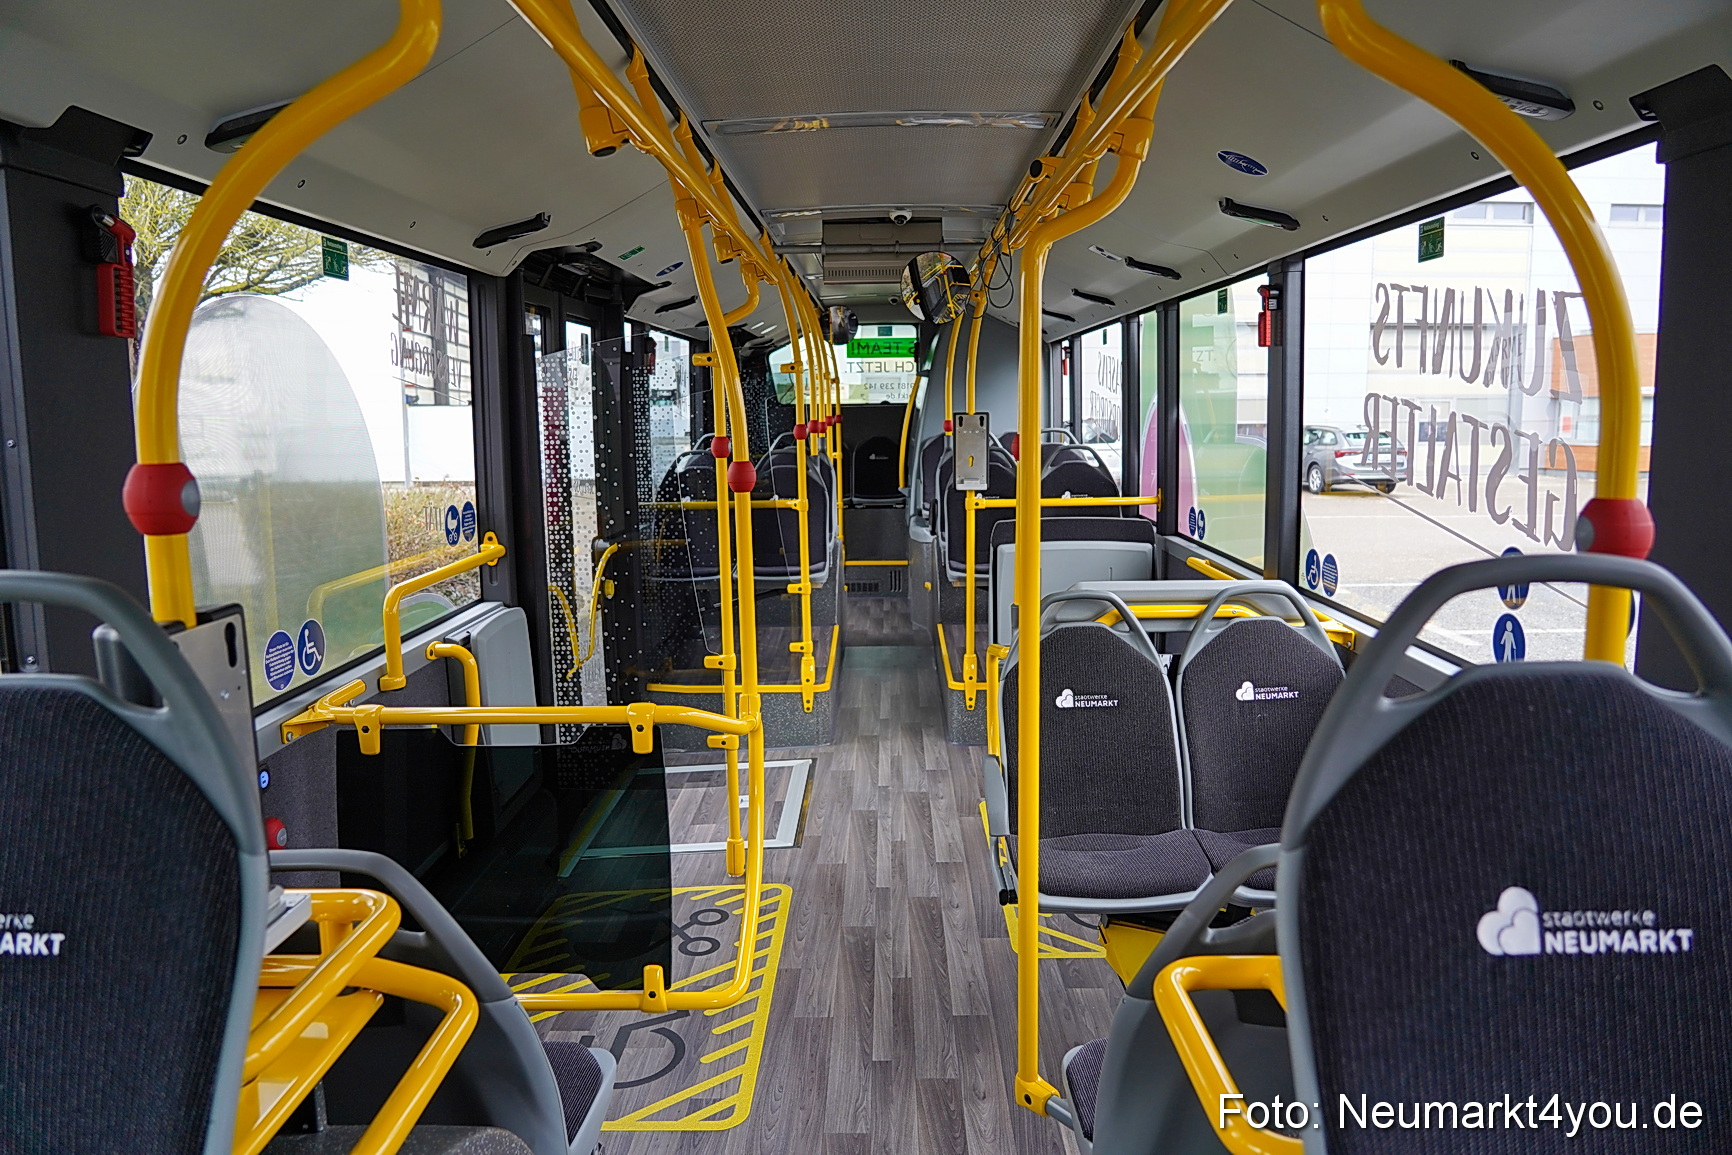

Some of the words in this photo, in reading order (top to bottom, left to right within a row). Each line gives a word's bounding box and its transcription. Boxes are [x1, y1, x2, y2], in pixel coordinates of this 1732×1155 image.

[1255, 691, 1299, 701] NEUMARKT
[1074, 699, 1119, 708] NEUMARKT
[1544, 928, 1693, 954] NEUMARKT
